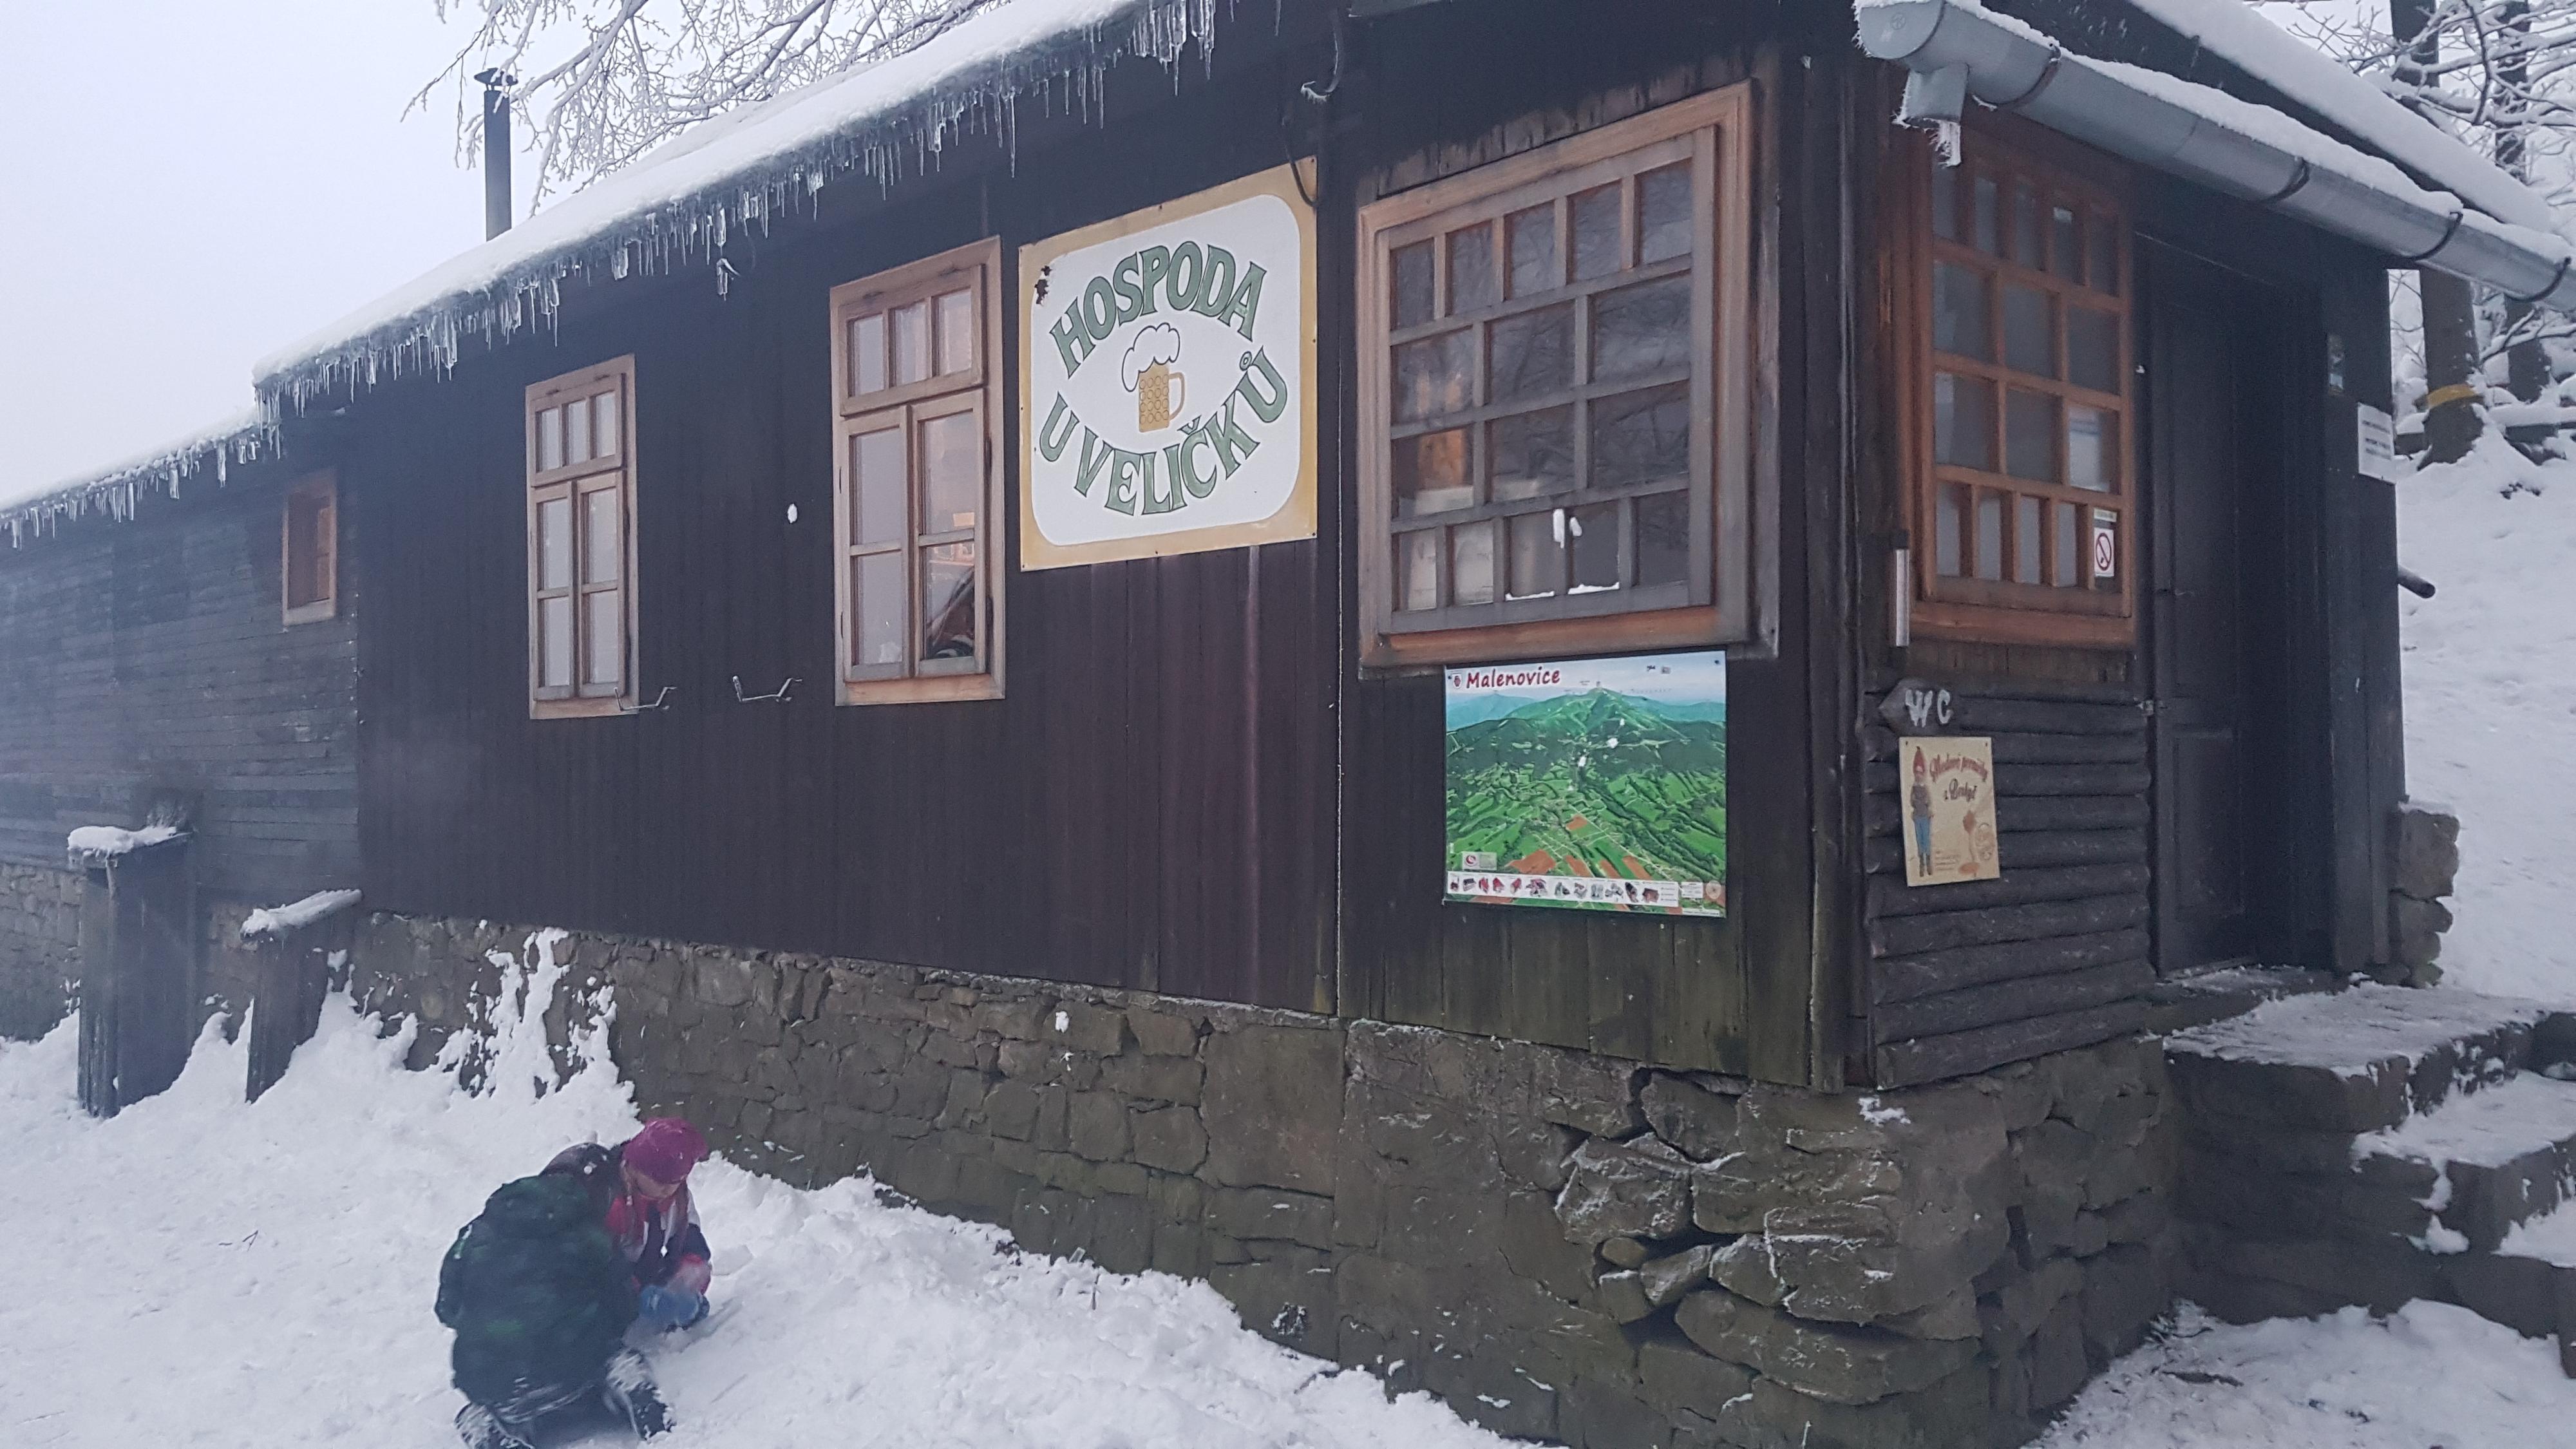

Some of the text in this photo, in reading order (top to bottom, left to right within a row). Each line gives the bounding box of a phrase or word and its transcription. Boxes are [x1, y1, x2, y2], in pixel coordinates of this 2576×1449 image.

[1048, 241, 1267, 379] HOSPODA
[1039, 345, 1289, 516] U VELIČKŮ
[1466, 666, 1561, 688] Malenovice
[1904, 688, 1954, 728] WC
